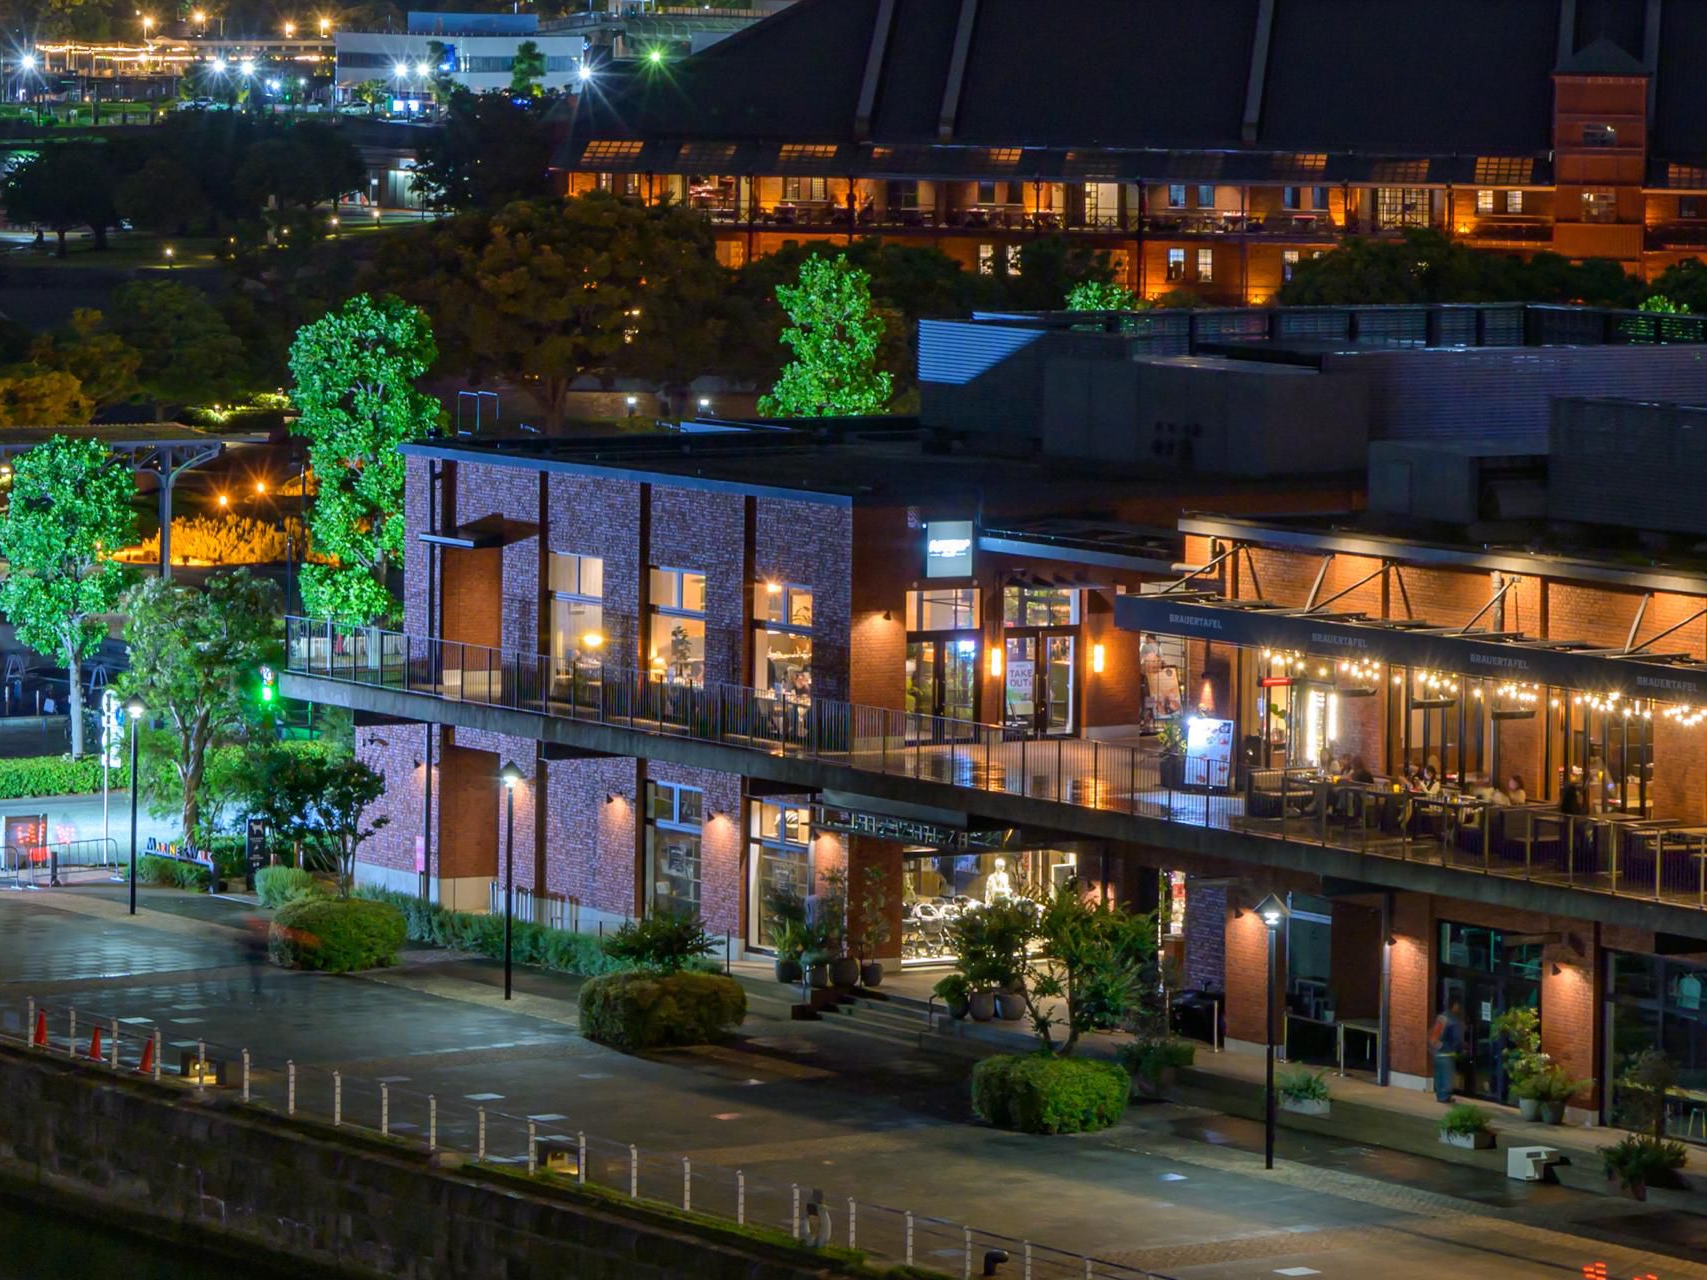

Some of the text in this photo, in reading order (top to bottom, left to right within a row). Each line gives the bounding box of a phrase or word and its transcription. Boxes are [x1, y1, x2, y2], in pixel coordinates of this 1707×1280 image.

[1169, 613, 1223, 630] BRAUERTAFEL
[1312, 632, 1367, 648] BRAUERTAFEL
[1470, 653, 1529, 670] BRAUERTAFEL
[1009, 669, 1033, 678] TAKE
[1637, 675, 1699, 692] BRAUERTAFEL
